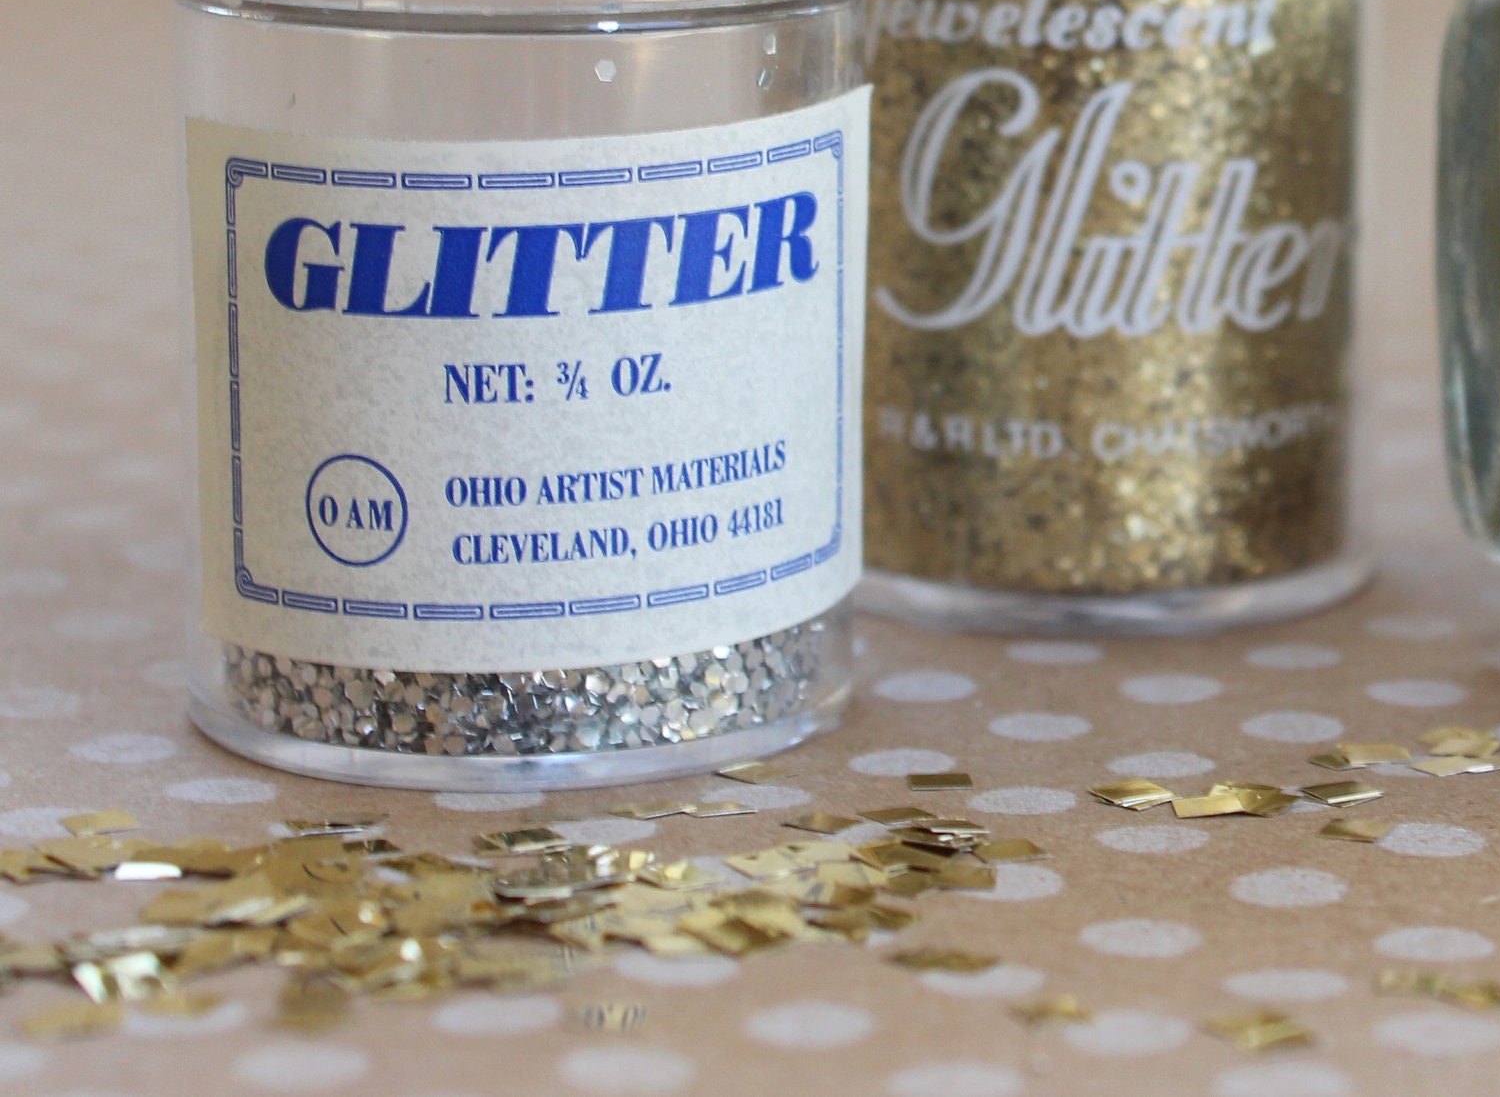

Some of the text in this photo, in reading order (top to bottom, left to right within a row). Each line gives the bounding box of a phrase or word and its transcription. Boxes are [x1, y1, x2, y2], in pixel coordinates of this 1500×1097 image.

[874, 66, 1354, 340] Glitter
[263, 190, 820, 319] GLITTER
[443, 363, 535, 405] NET:
[610, 352, 672, 398] OZ.
[445, 439, 787, 509] OHIO ARTIST MATERIALS
[452, 496, 785, 566] CLEVELAND, OHIO 44181
